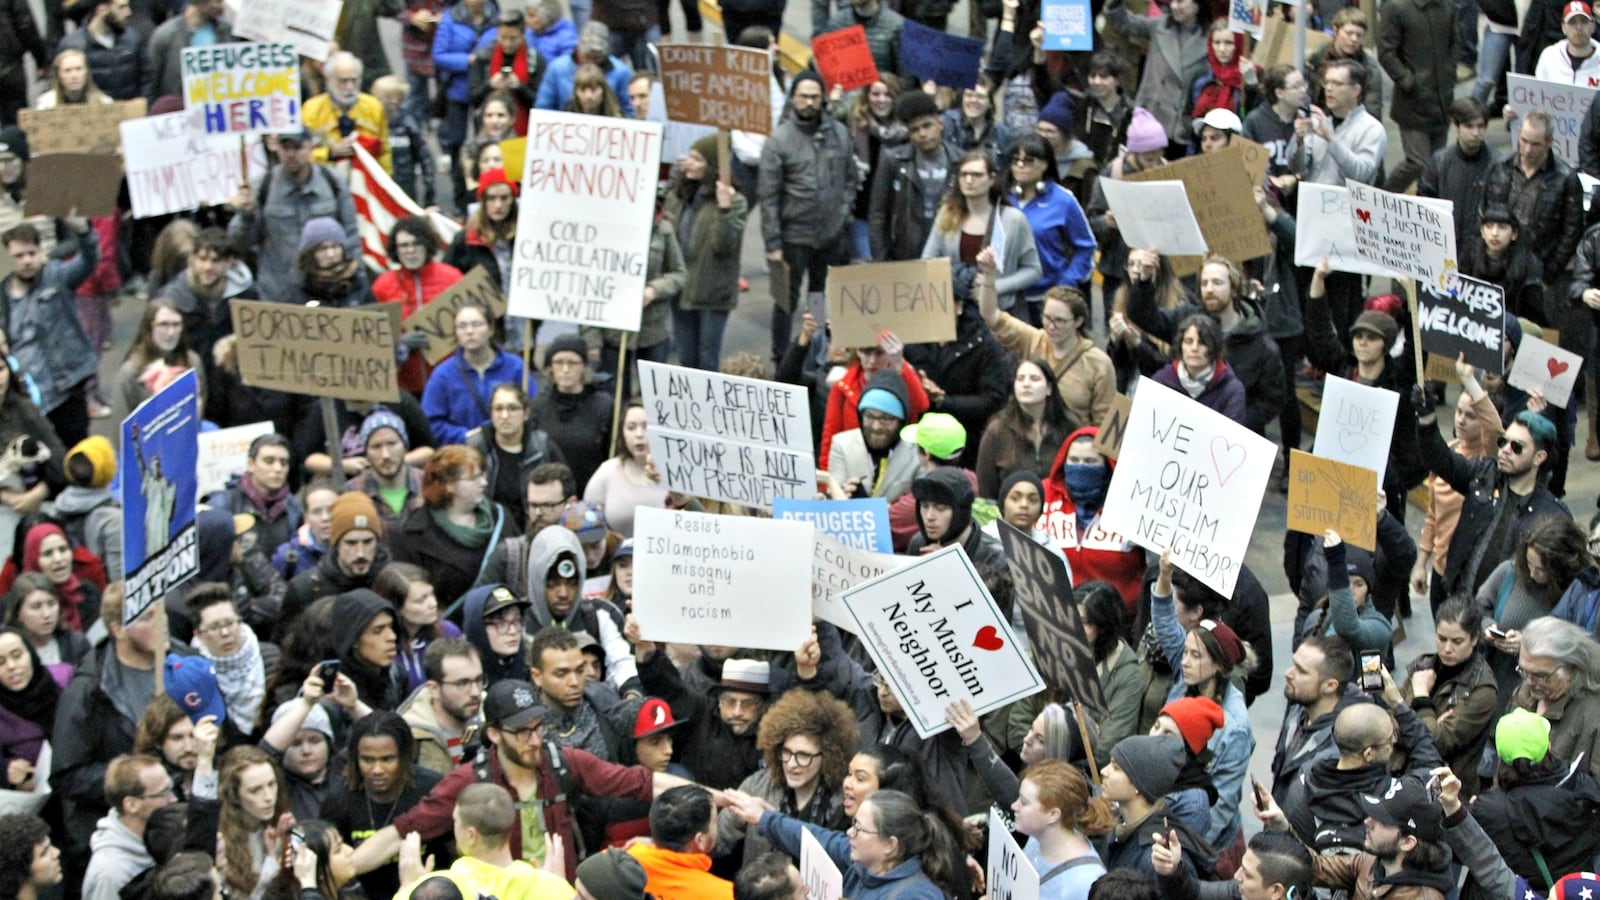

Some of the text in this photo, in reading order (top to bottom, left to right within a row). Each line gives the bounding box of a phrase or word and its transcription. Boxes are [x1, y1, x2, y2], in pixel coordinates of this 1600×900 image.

[184, 44, 295, 75] REFUGEES
[726, 50, 770, 77] KILL
[188, 67, 297, 104] WELCOME
[664, 70, 703, 94] THE
[1512, 86, 1592, 114] atheis
[204, 98, 296, 133] HERE!
[534, 121, 658, 164] PRESIDENT
[529, 158, 646, 204] BANNON:
[1373, 192, 1413, 219] FIGHT
[1417, 204, 1442, 229] FOR
[549, 220, 598, 244] COLD
[1392, 218, 1448, 254] JUSTICE!
[519, 239, 644, 278] CALCULATING
[516, 265, 616, 301] PLOTTING
[839, 280, 948, 317] NO BAN
[1421, 279, 1503, 320] RUGEES
[239, 306, 391, 348] BORDERS ARE
[414, 306, 456, 339] NO
[1418, 301, 1502, 351] WELCOME
[250, 344, 391, 391] IMAGINARY
[651, 369, 796, 418] I AM A REFUGEE
[655, 400, 671, 426] &
[712, 405, 789, 446] CITIZEN
[1152, 407, 1195, 455] WE
[1336, 396, 1383, 436] LOVE
[658, 434, 800, 482] TRUMP IS NOT
[665, 461, 694, 491] MY
[1297, 468, 1317, 484] DID
[1159, 460, 1210, 507] OUR
[674, 513, 721, 535] Resist
[1130, 479, 1220, 543] MUSLIM
[1294, 504, 1335, 524] STUTTER
[1008, 530, 1056, 586] NO
[1136, 514, 1240, 590] NEIGHBORS
[125, 545, 197, 623] NATION
[671, 562, 732, 585] misogny
[688, 580, 715, 595] and
[681, 602, 732, 620] racism
[954, 598, 974, 612] I
[1007, 558, 1076, 629] BAN
[882, 601, 950, 700] Neighbor
[906, 579, 985, 698] My Muslim
[1037, 621, 1077, 668] NO
[1002, 842, 1018, 881] NO
